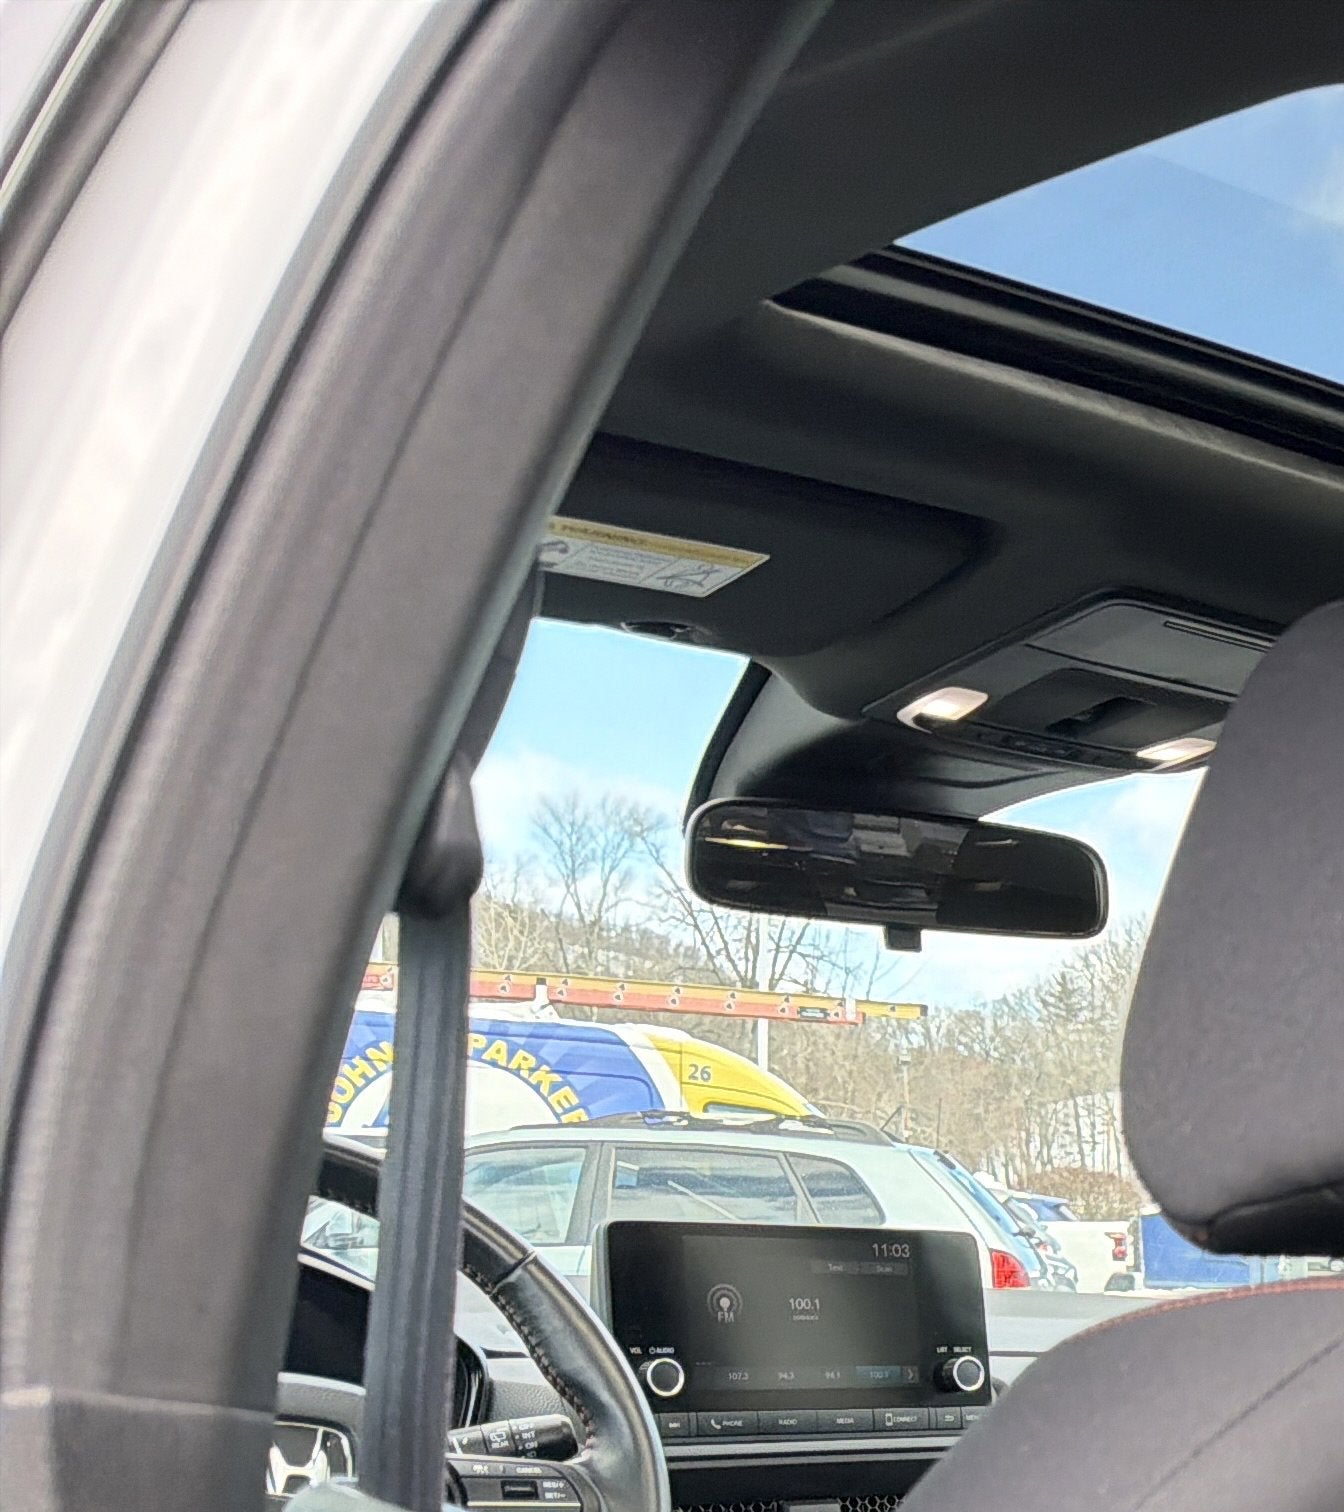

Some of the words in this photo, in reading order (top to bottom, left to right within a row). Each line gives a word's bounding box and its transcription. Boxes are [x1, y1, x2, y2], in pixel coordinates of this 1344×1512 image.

[687, 1063, 712, 1082] 26
[872, 1243, 910, 1258] 11:03
[789, 1297, 820, 1311] 100.1
[717, 1311, 735, 1323] FM
